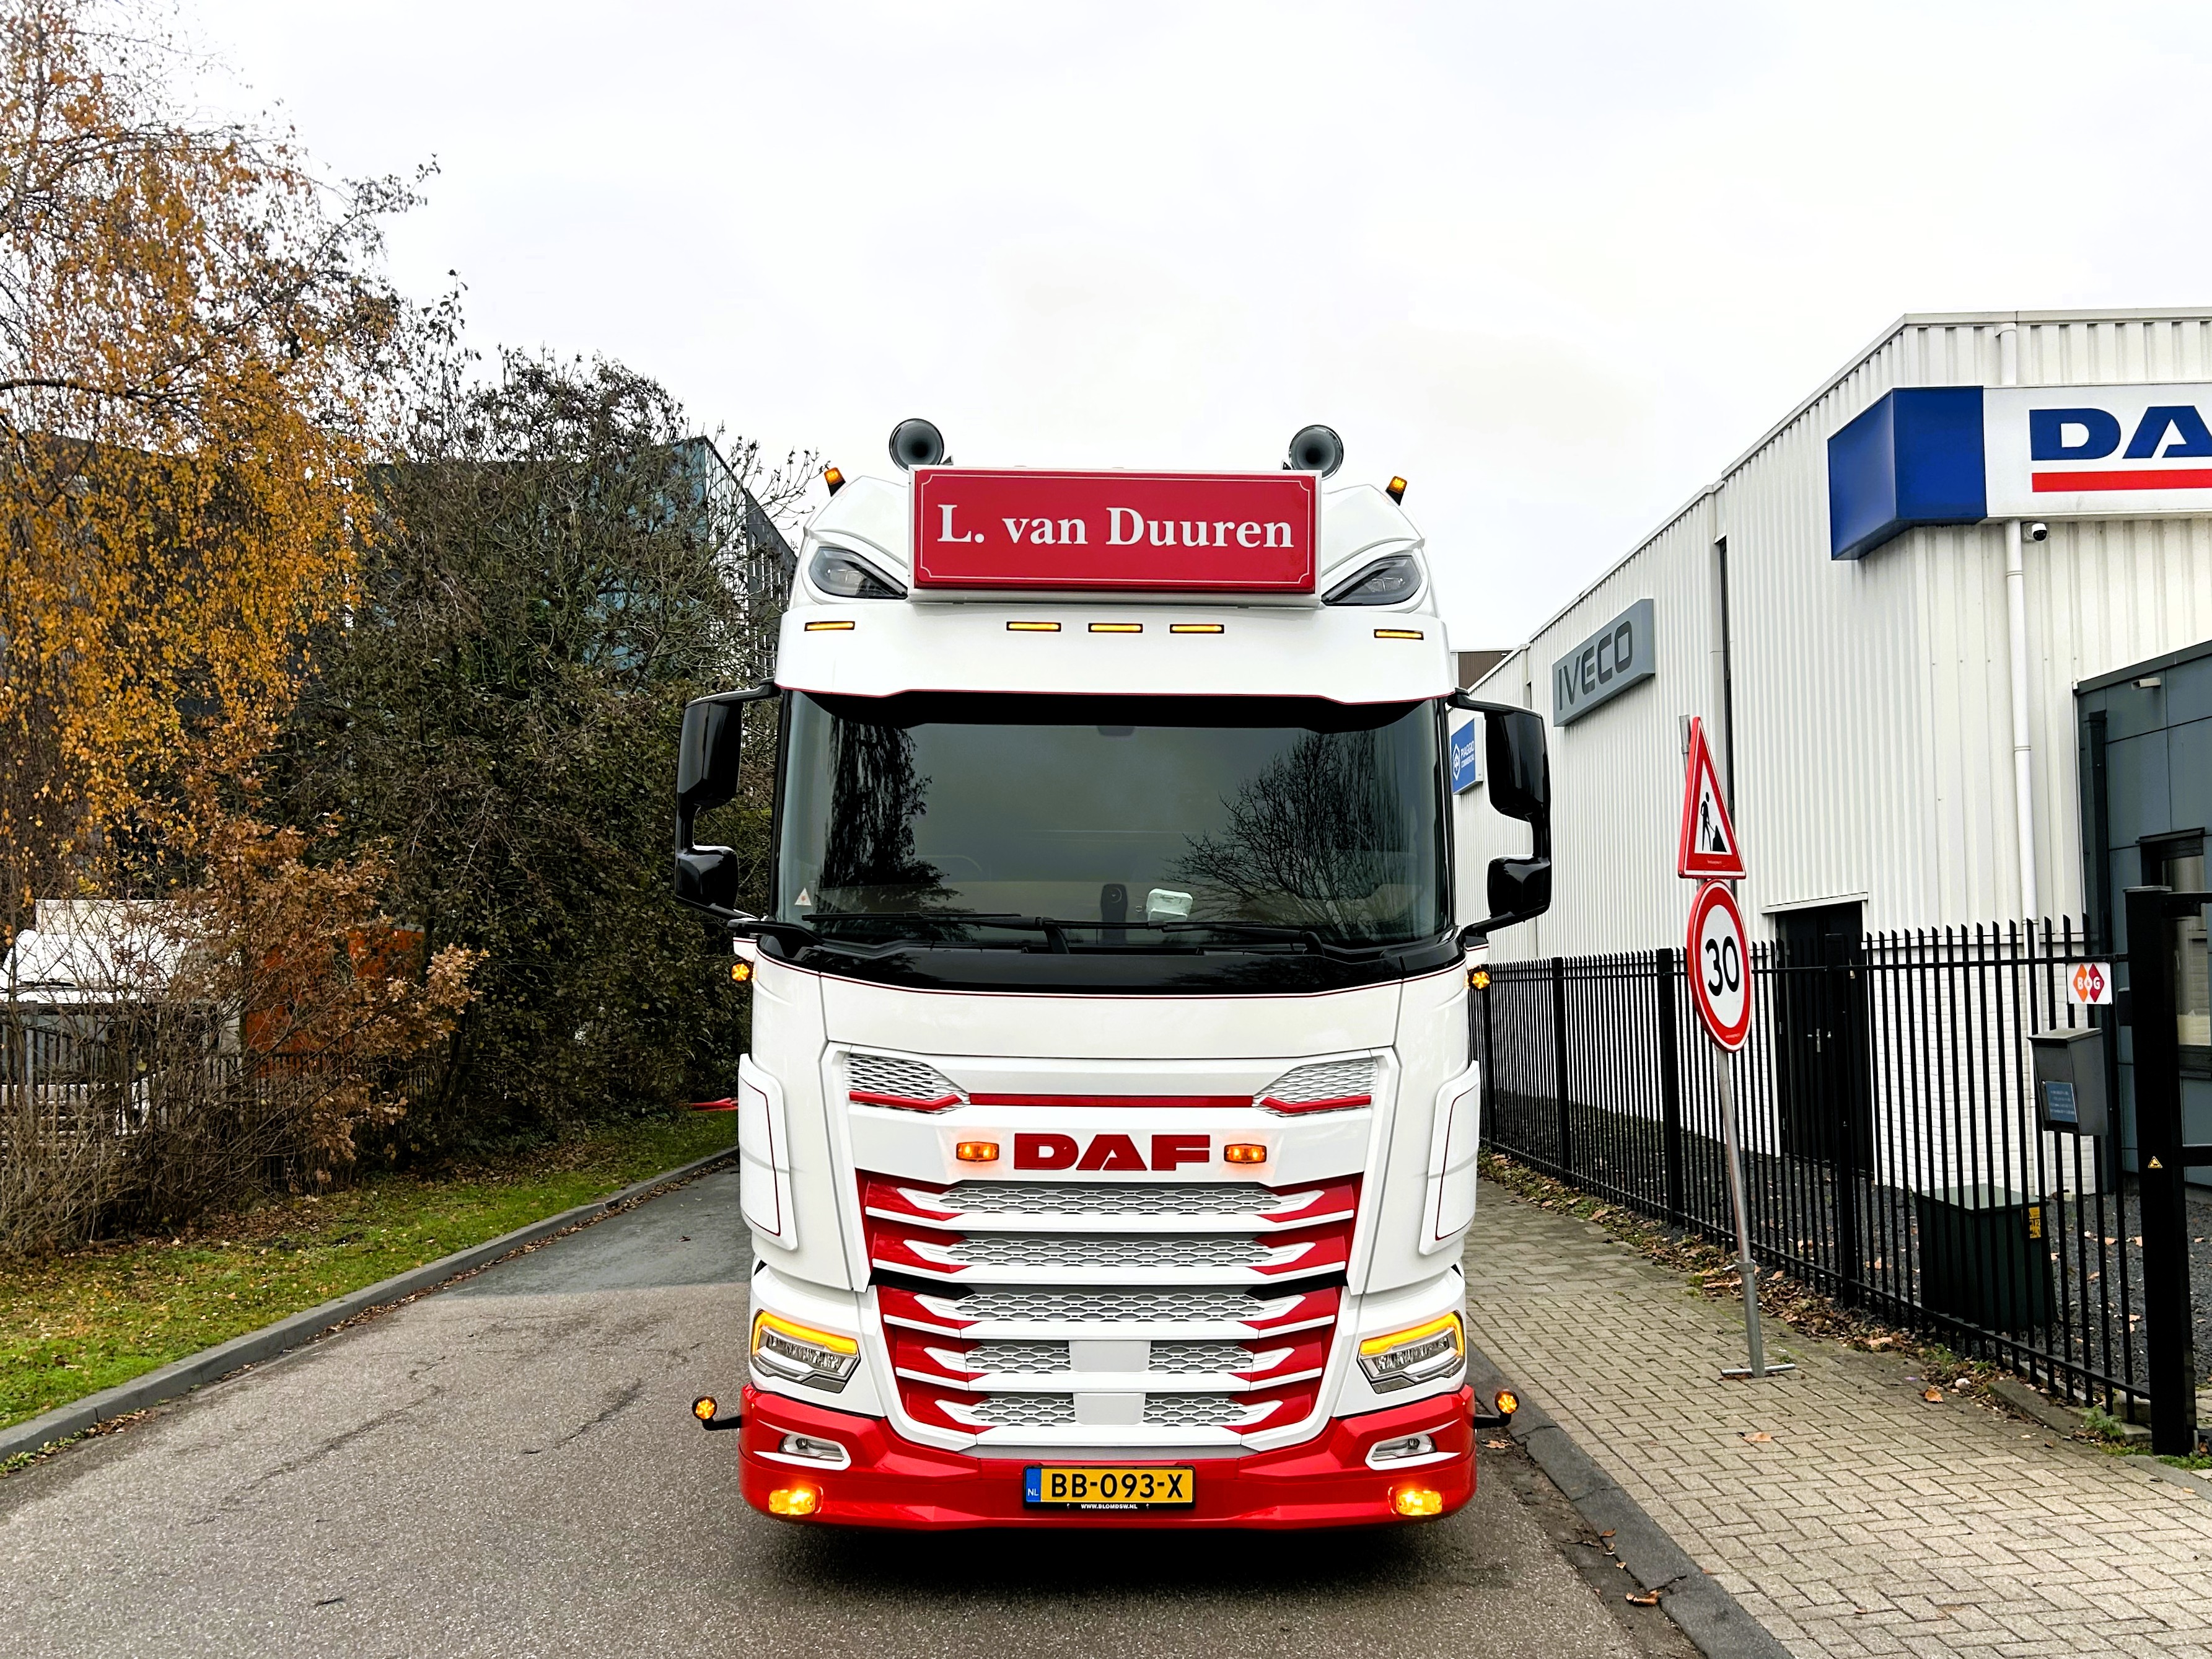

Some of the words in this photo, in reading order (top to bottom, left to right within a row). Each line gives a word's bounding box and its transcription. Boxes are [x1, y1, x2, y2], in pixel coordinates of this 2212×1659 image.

[937, 504, 985, 543] L.
[1002, 517, 1088, 545] van
[1105, 507, 1294, 548] Duuren
[1558, 621, 1633, 711] IVECO
[1705, 936, 1740, 997] 30
[1014, 1132, 1210, 1171] DAF
[1027, 1488, 1039, 1496] NL
[1051, 1473, 1183, 1498] BB-093-X
